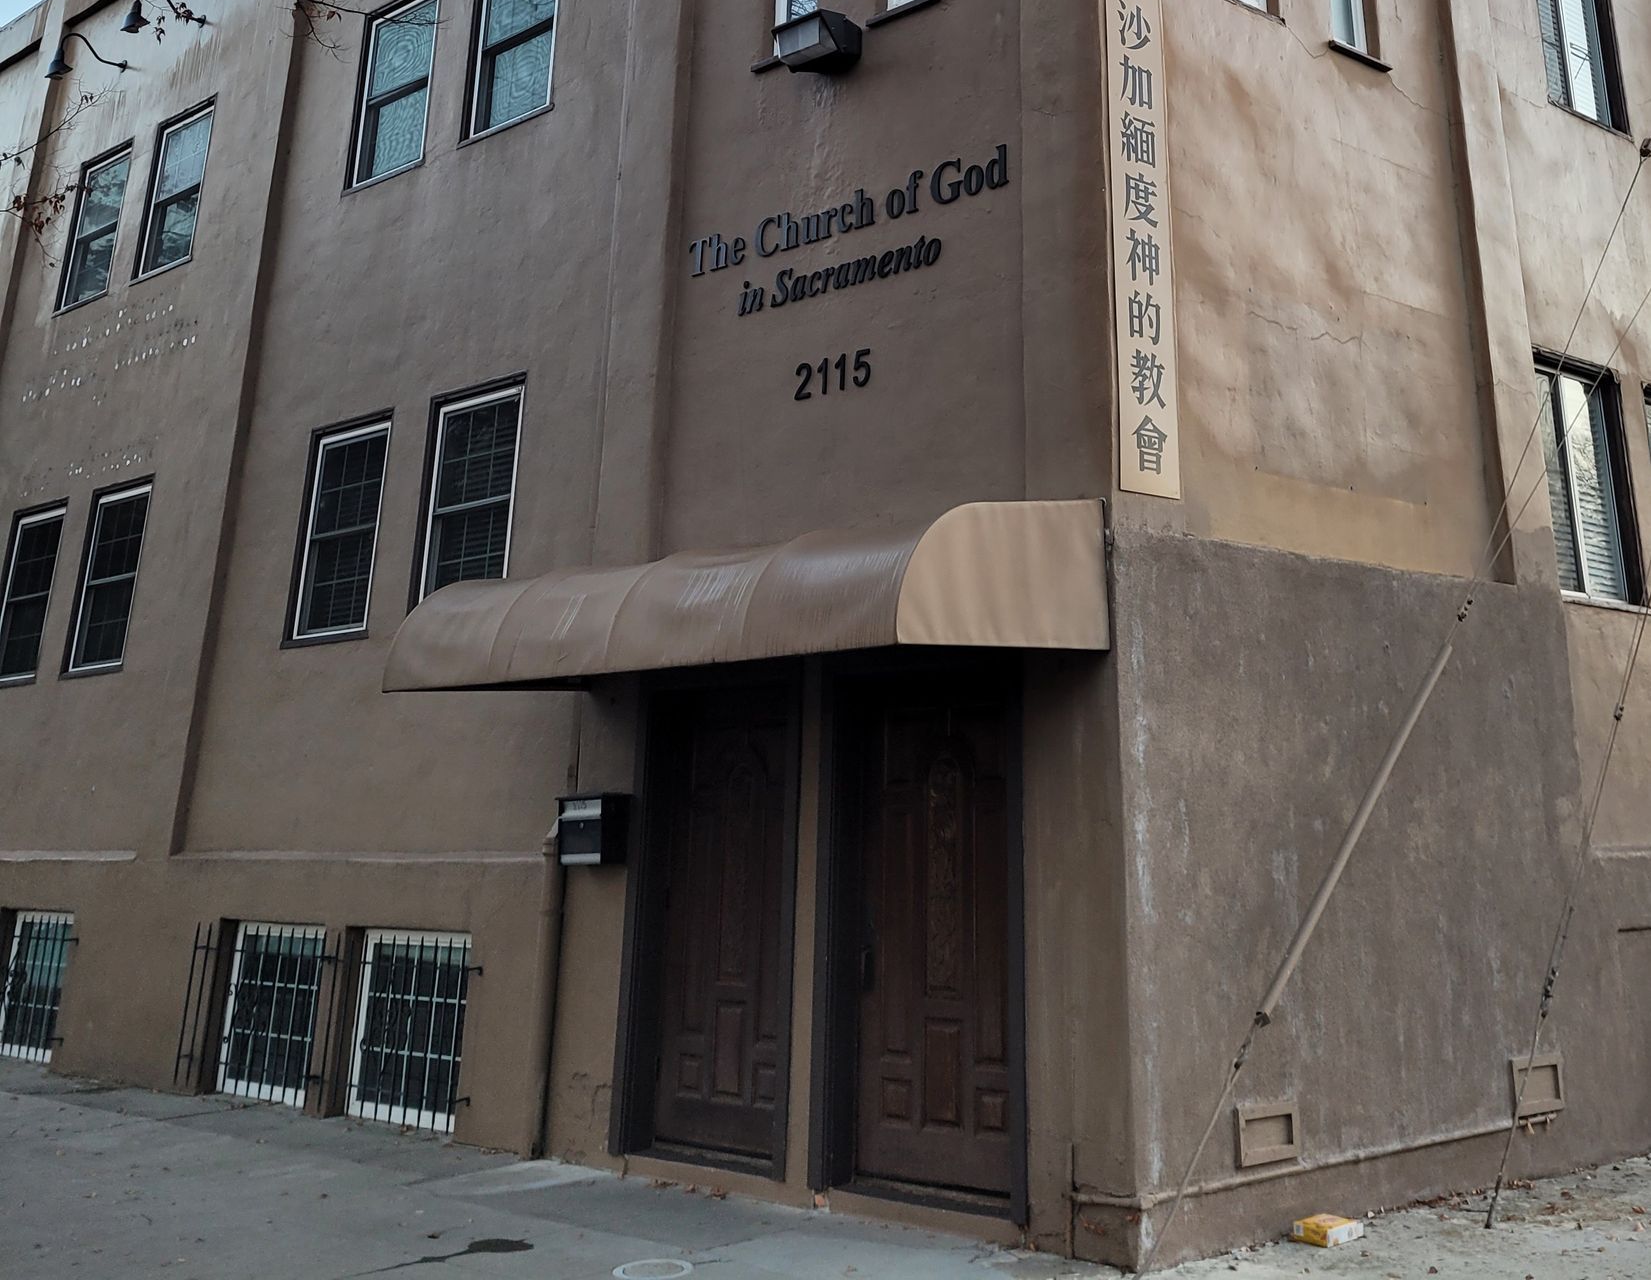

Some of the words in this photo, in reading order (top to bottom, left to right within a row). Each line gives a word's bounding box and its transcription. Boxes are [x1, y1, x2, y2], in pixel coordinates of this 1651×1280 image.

[689, 233, 746, 277] The
[755, 188, 875, 258] Church
[886, 169, 924, 219] of
[930, 143, 1010, 205] God
[737, 280, 764, 317] in
[770, 235, 942, 308] Sacramento
[794, 348, 871, 401] 2115
